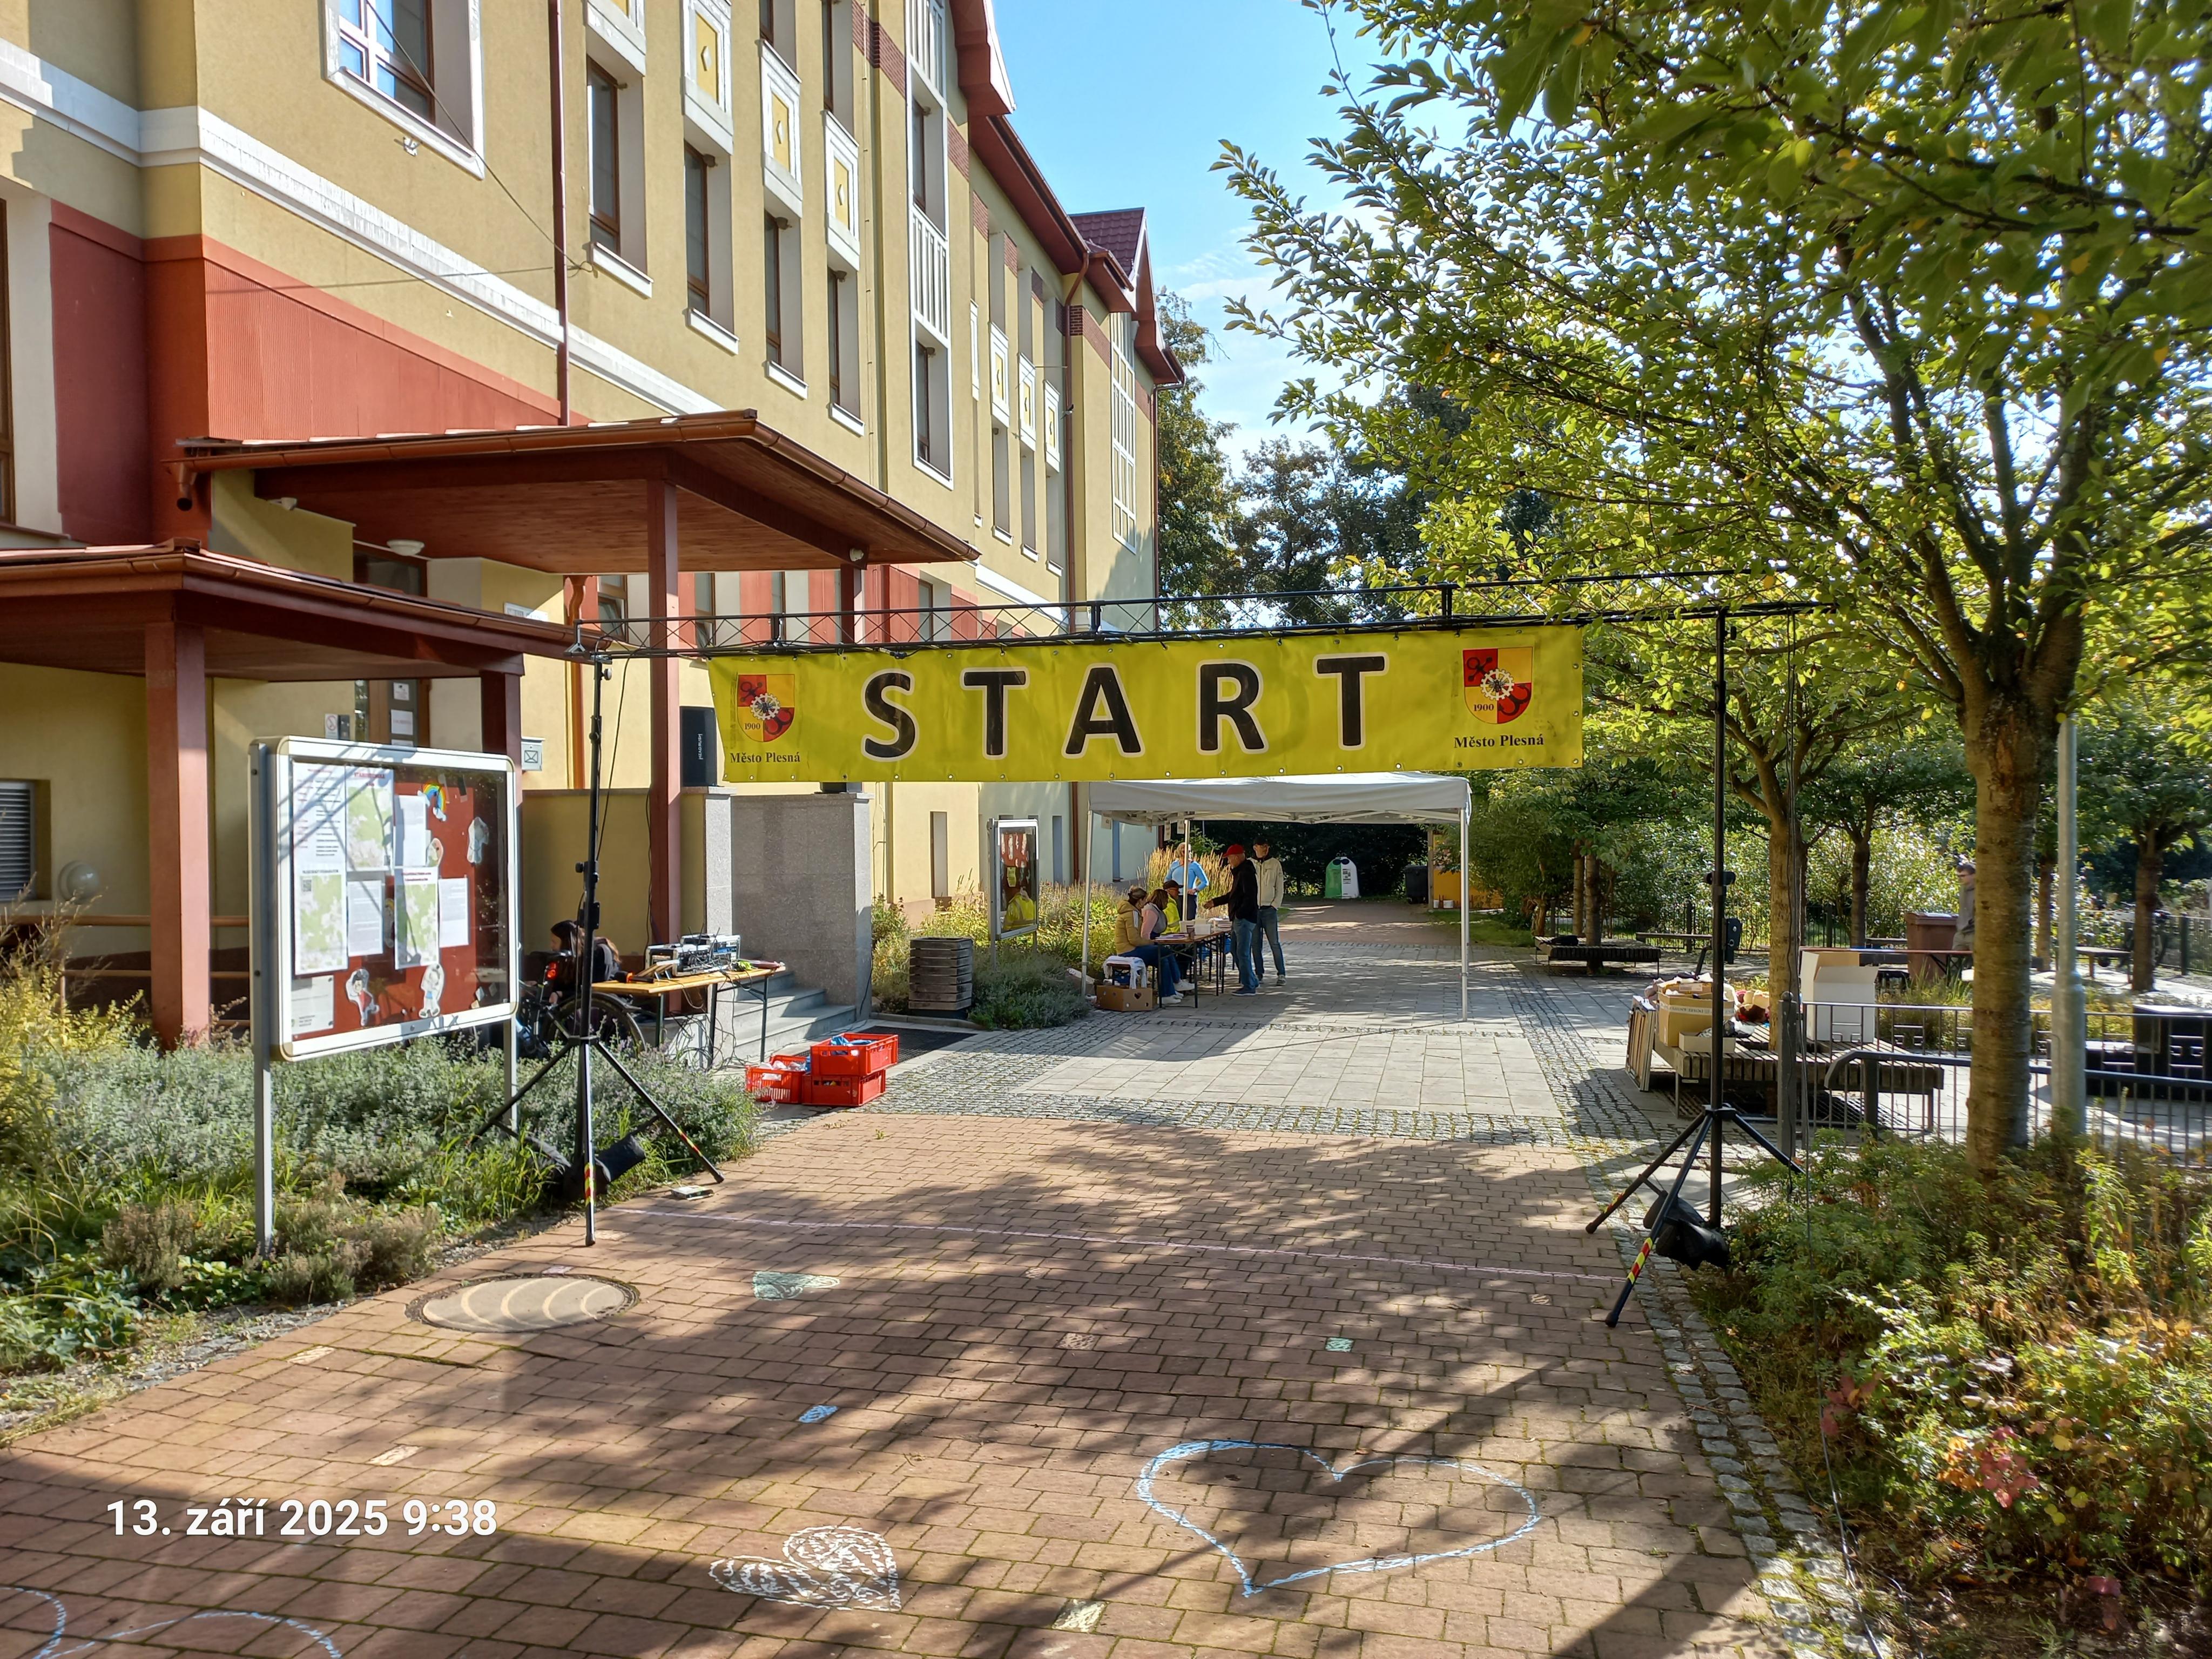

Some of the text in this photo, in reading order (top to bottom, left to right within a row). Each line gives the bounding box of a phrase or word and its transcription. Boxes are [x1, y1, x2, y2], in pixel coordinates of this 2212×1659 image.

[864, 656, 1386, 759] START
[1473, 703, 1494, 712] 1900
[744, 722, 760, 730] 1900
[1454, 733, 1544, 748] Město Plesná
[730, 751, 801, 764] Město Plesná
